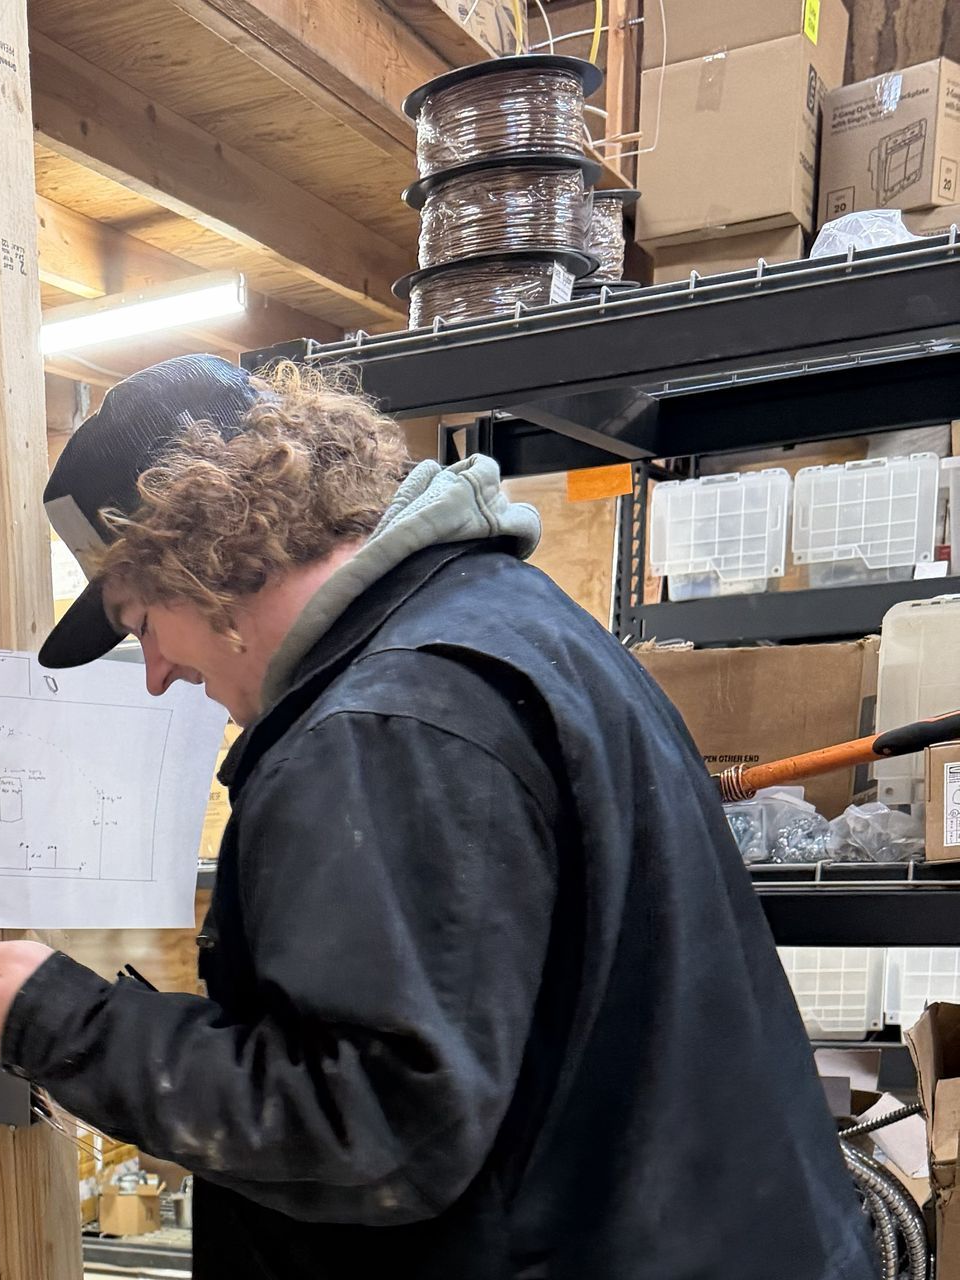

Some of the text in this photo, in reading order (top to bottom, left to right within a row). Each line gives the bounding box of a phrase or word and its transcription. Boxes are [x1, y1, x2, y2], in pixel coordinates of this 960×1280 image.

[834, 202, 847, 213] 20
[703, 754, 760, 763] PEN OTHER END
